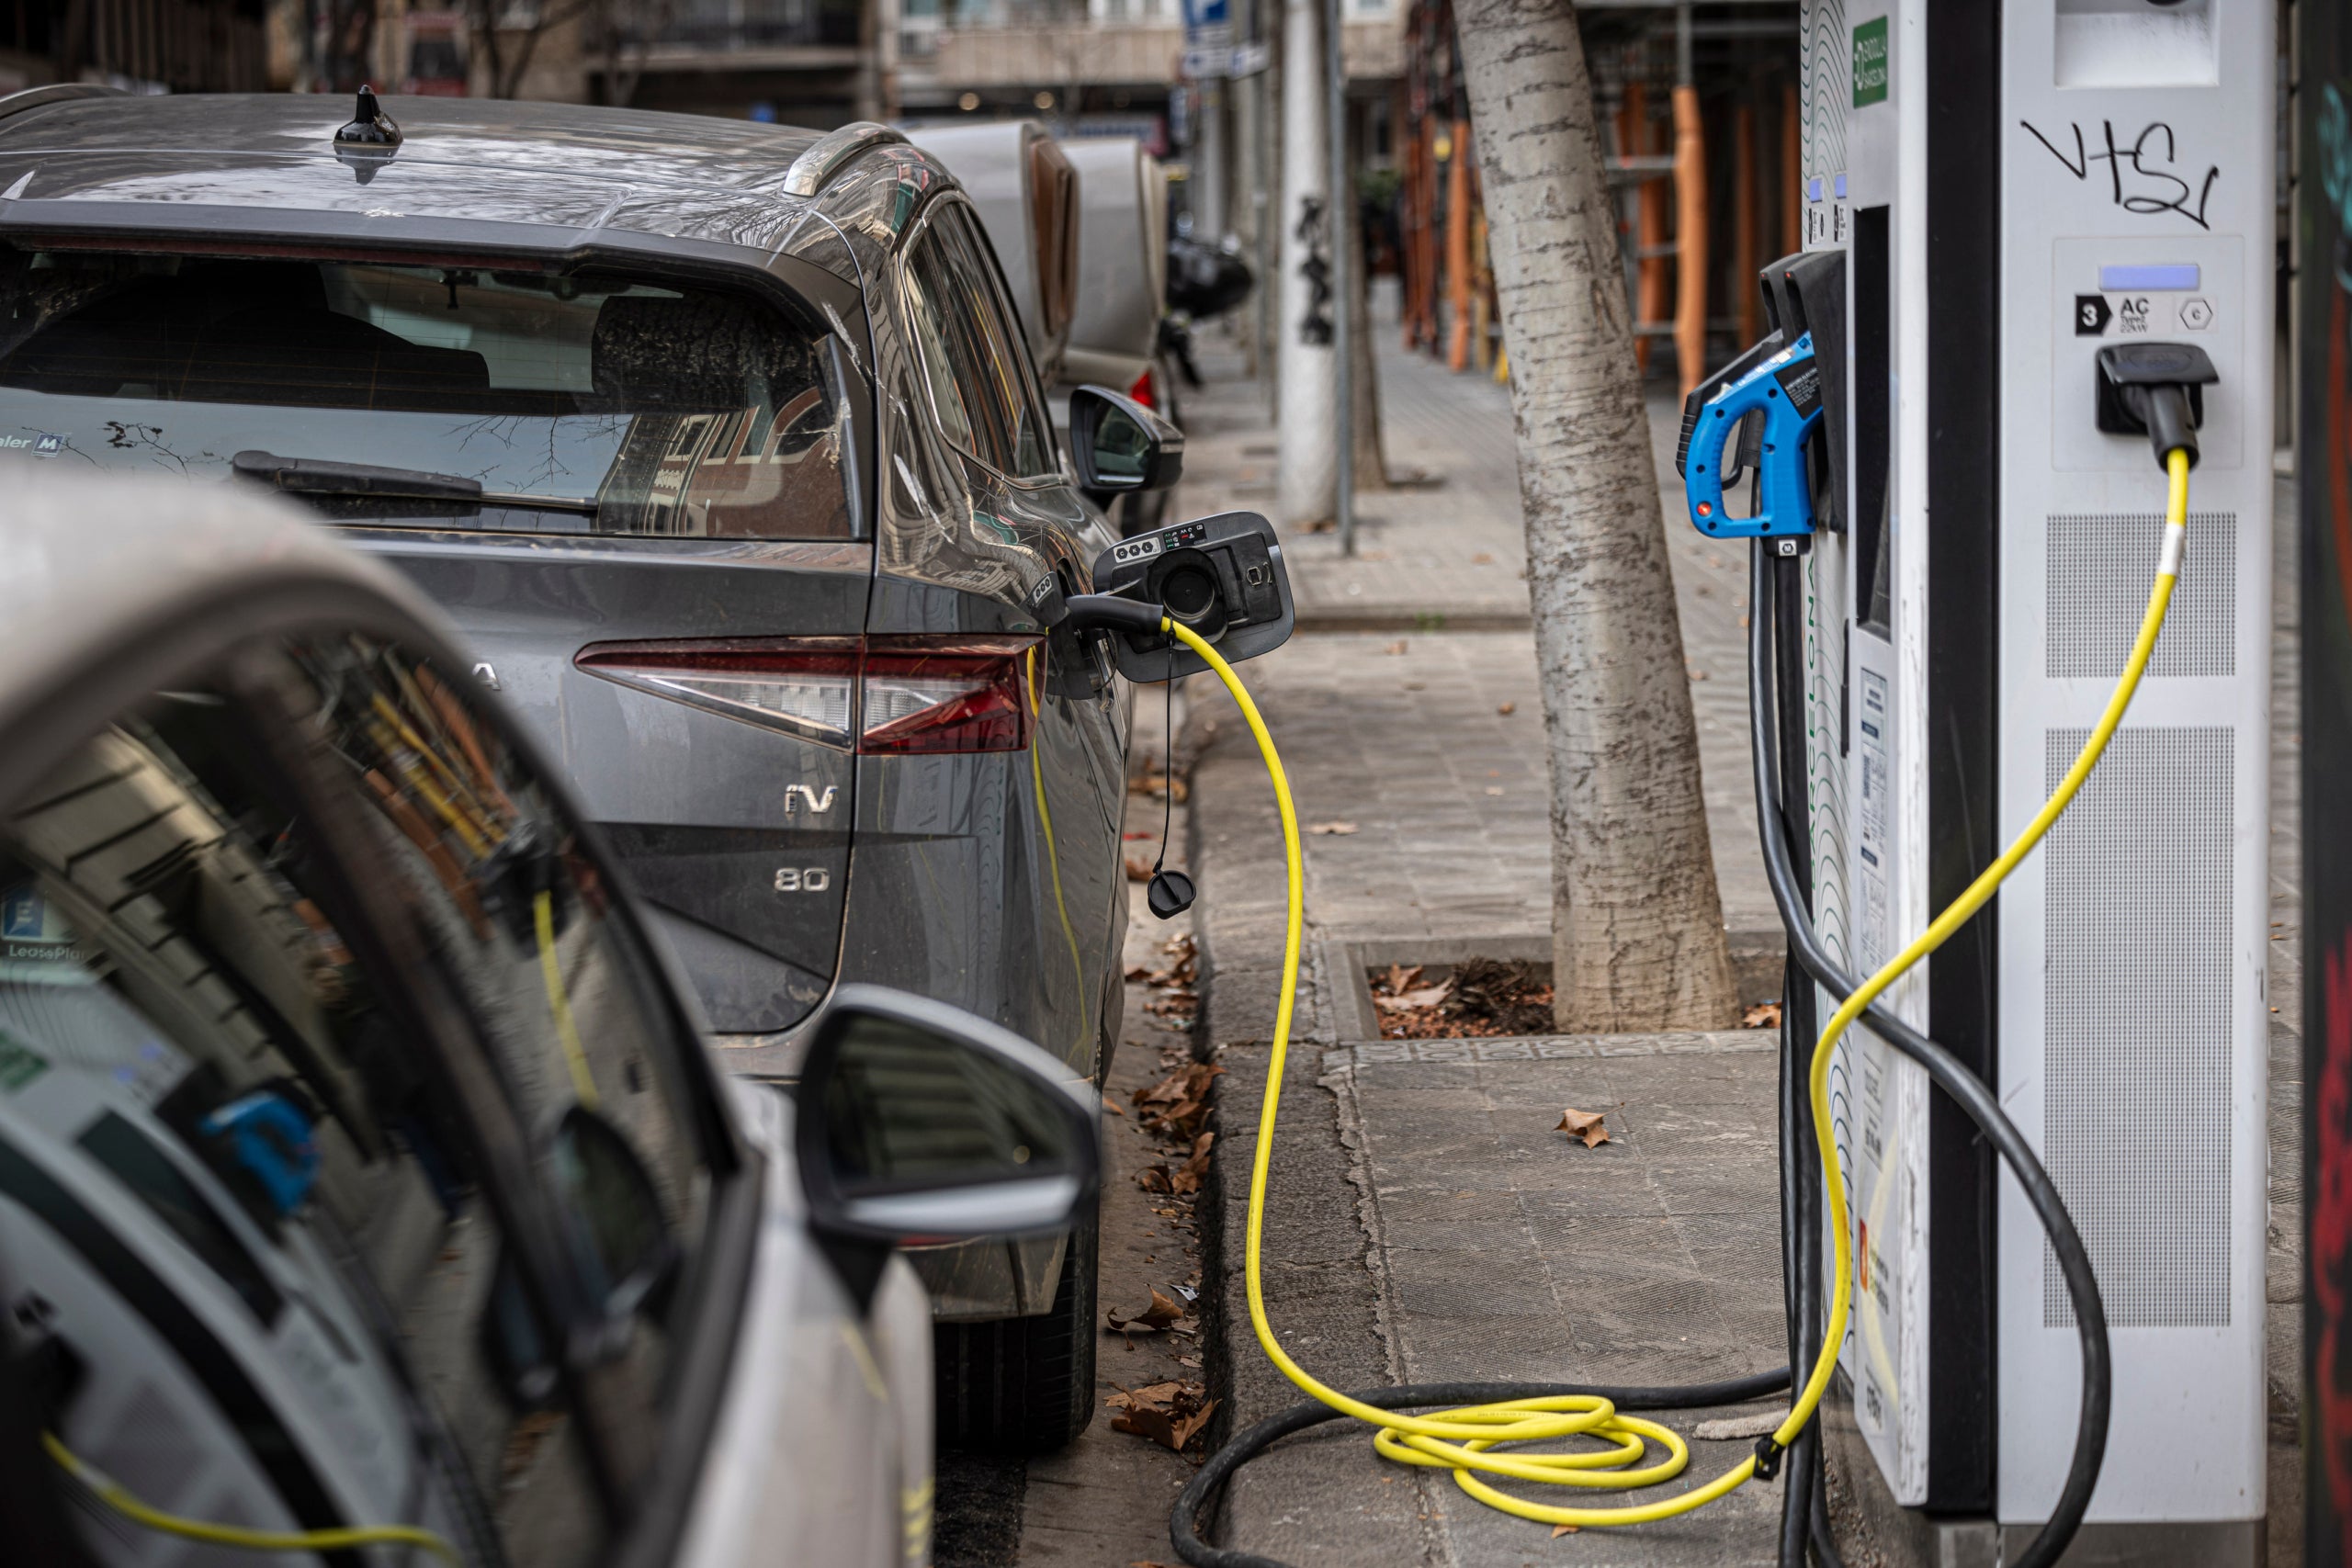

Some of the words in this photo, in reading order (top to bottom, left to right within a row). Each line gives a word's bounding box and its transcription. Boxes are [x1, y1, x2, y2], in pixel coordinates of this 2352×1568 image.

[2081, 302, 2098, 327] 3
[2120, 298, 2149, 314] AC
[775, 868, 830, 891] 80
